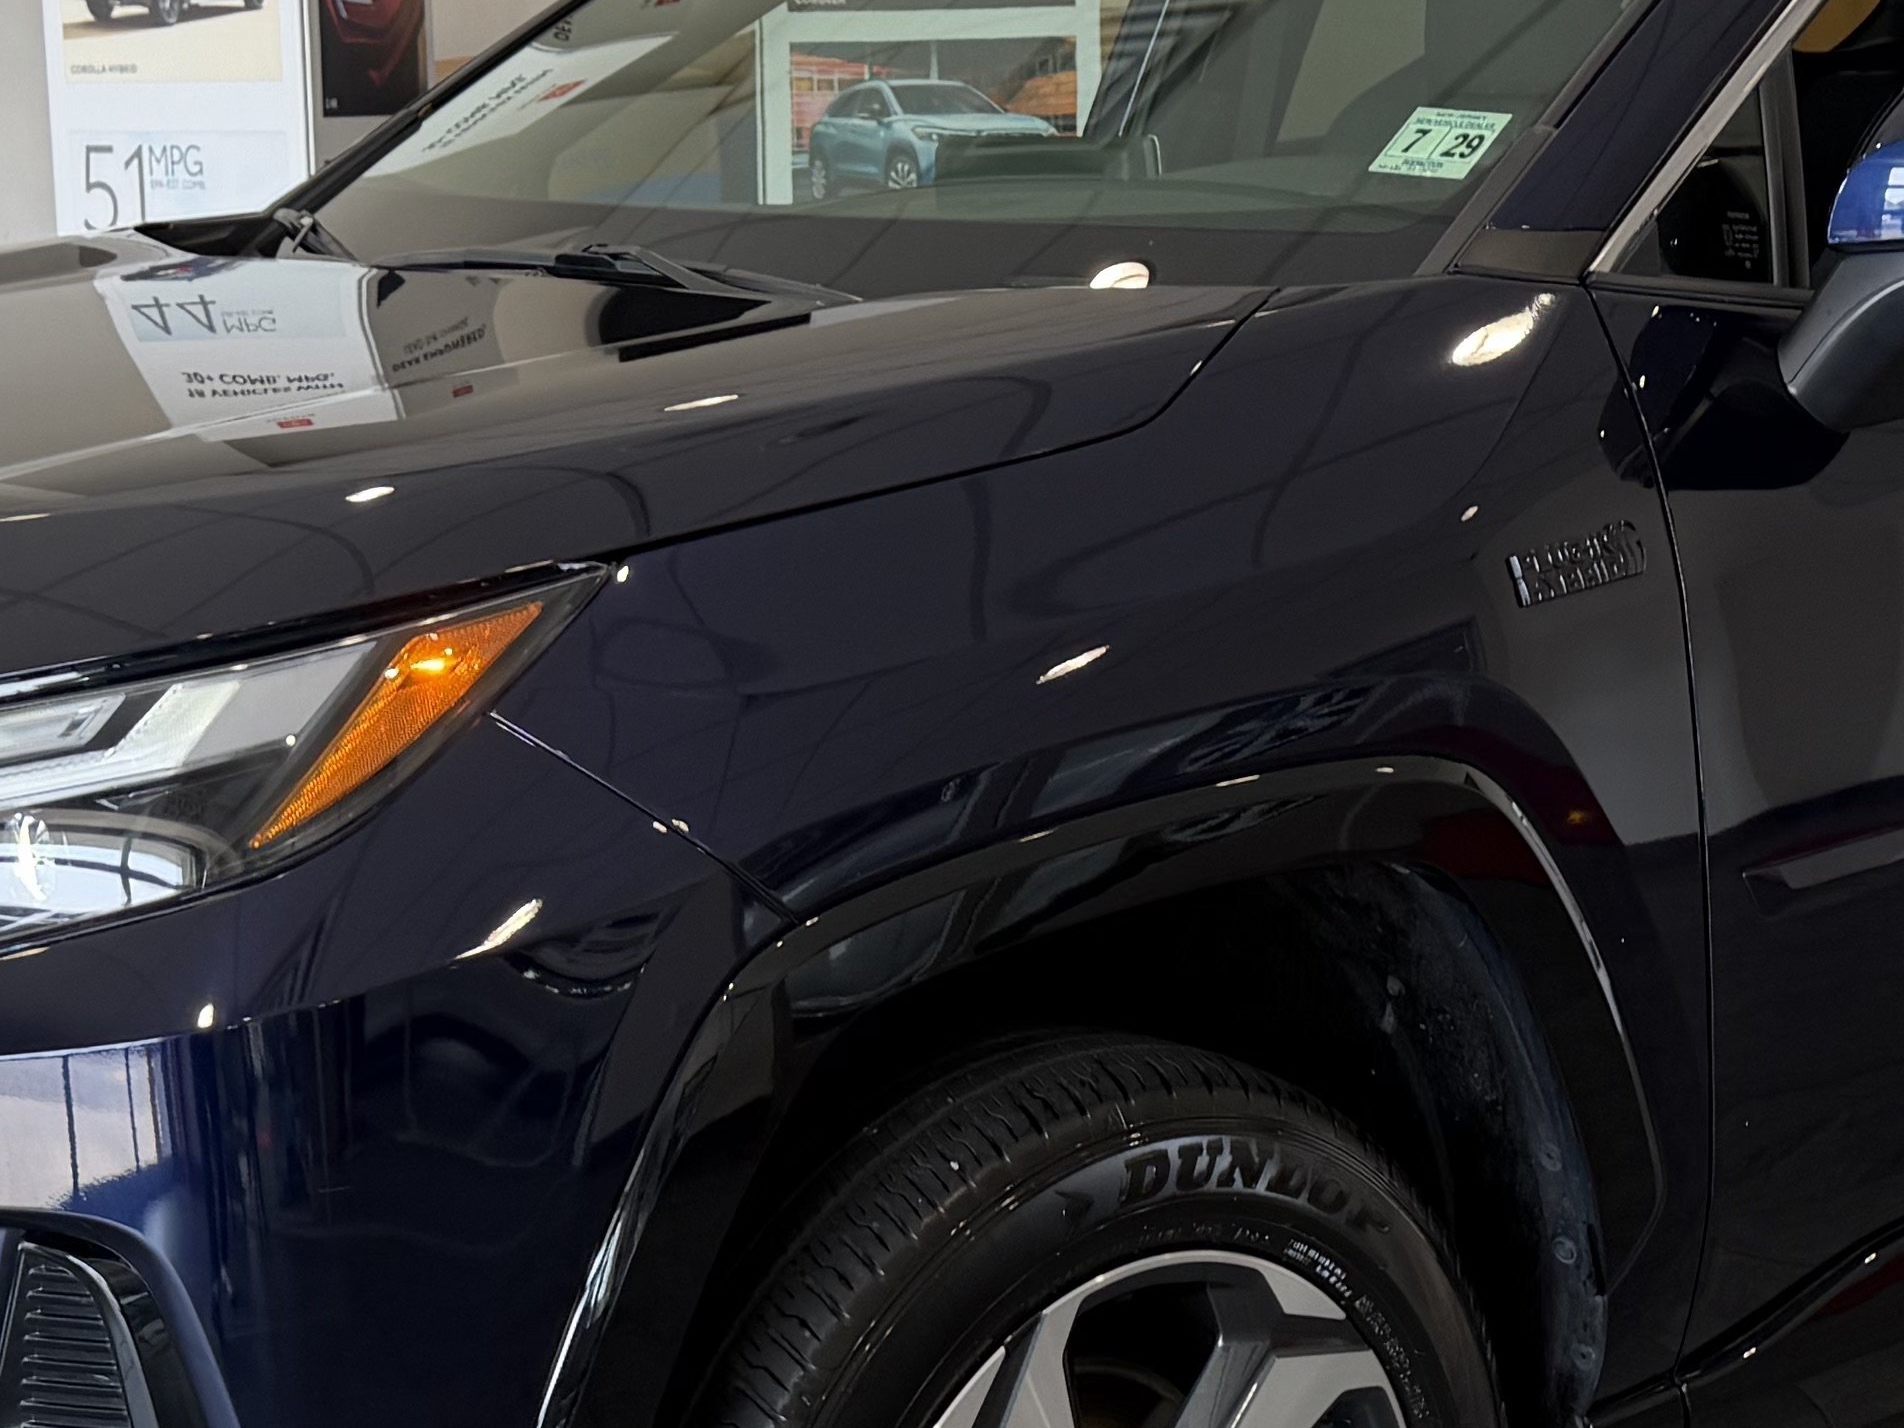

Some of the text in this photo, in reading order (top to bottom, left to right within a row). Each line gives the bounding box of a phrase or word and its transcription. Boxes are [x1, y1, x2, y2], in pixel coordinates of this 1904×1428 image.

[83, 143, 204, 231] 51 MPG
[1400, 128, 1486, 159] 7 29
[1118, 1134, 1391, 1235] DUNLOP
